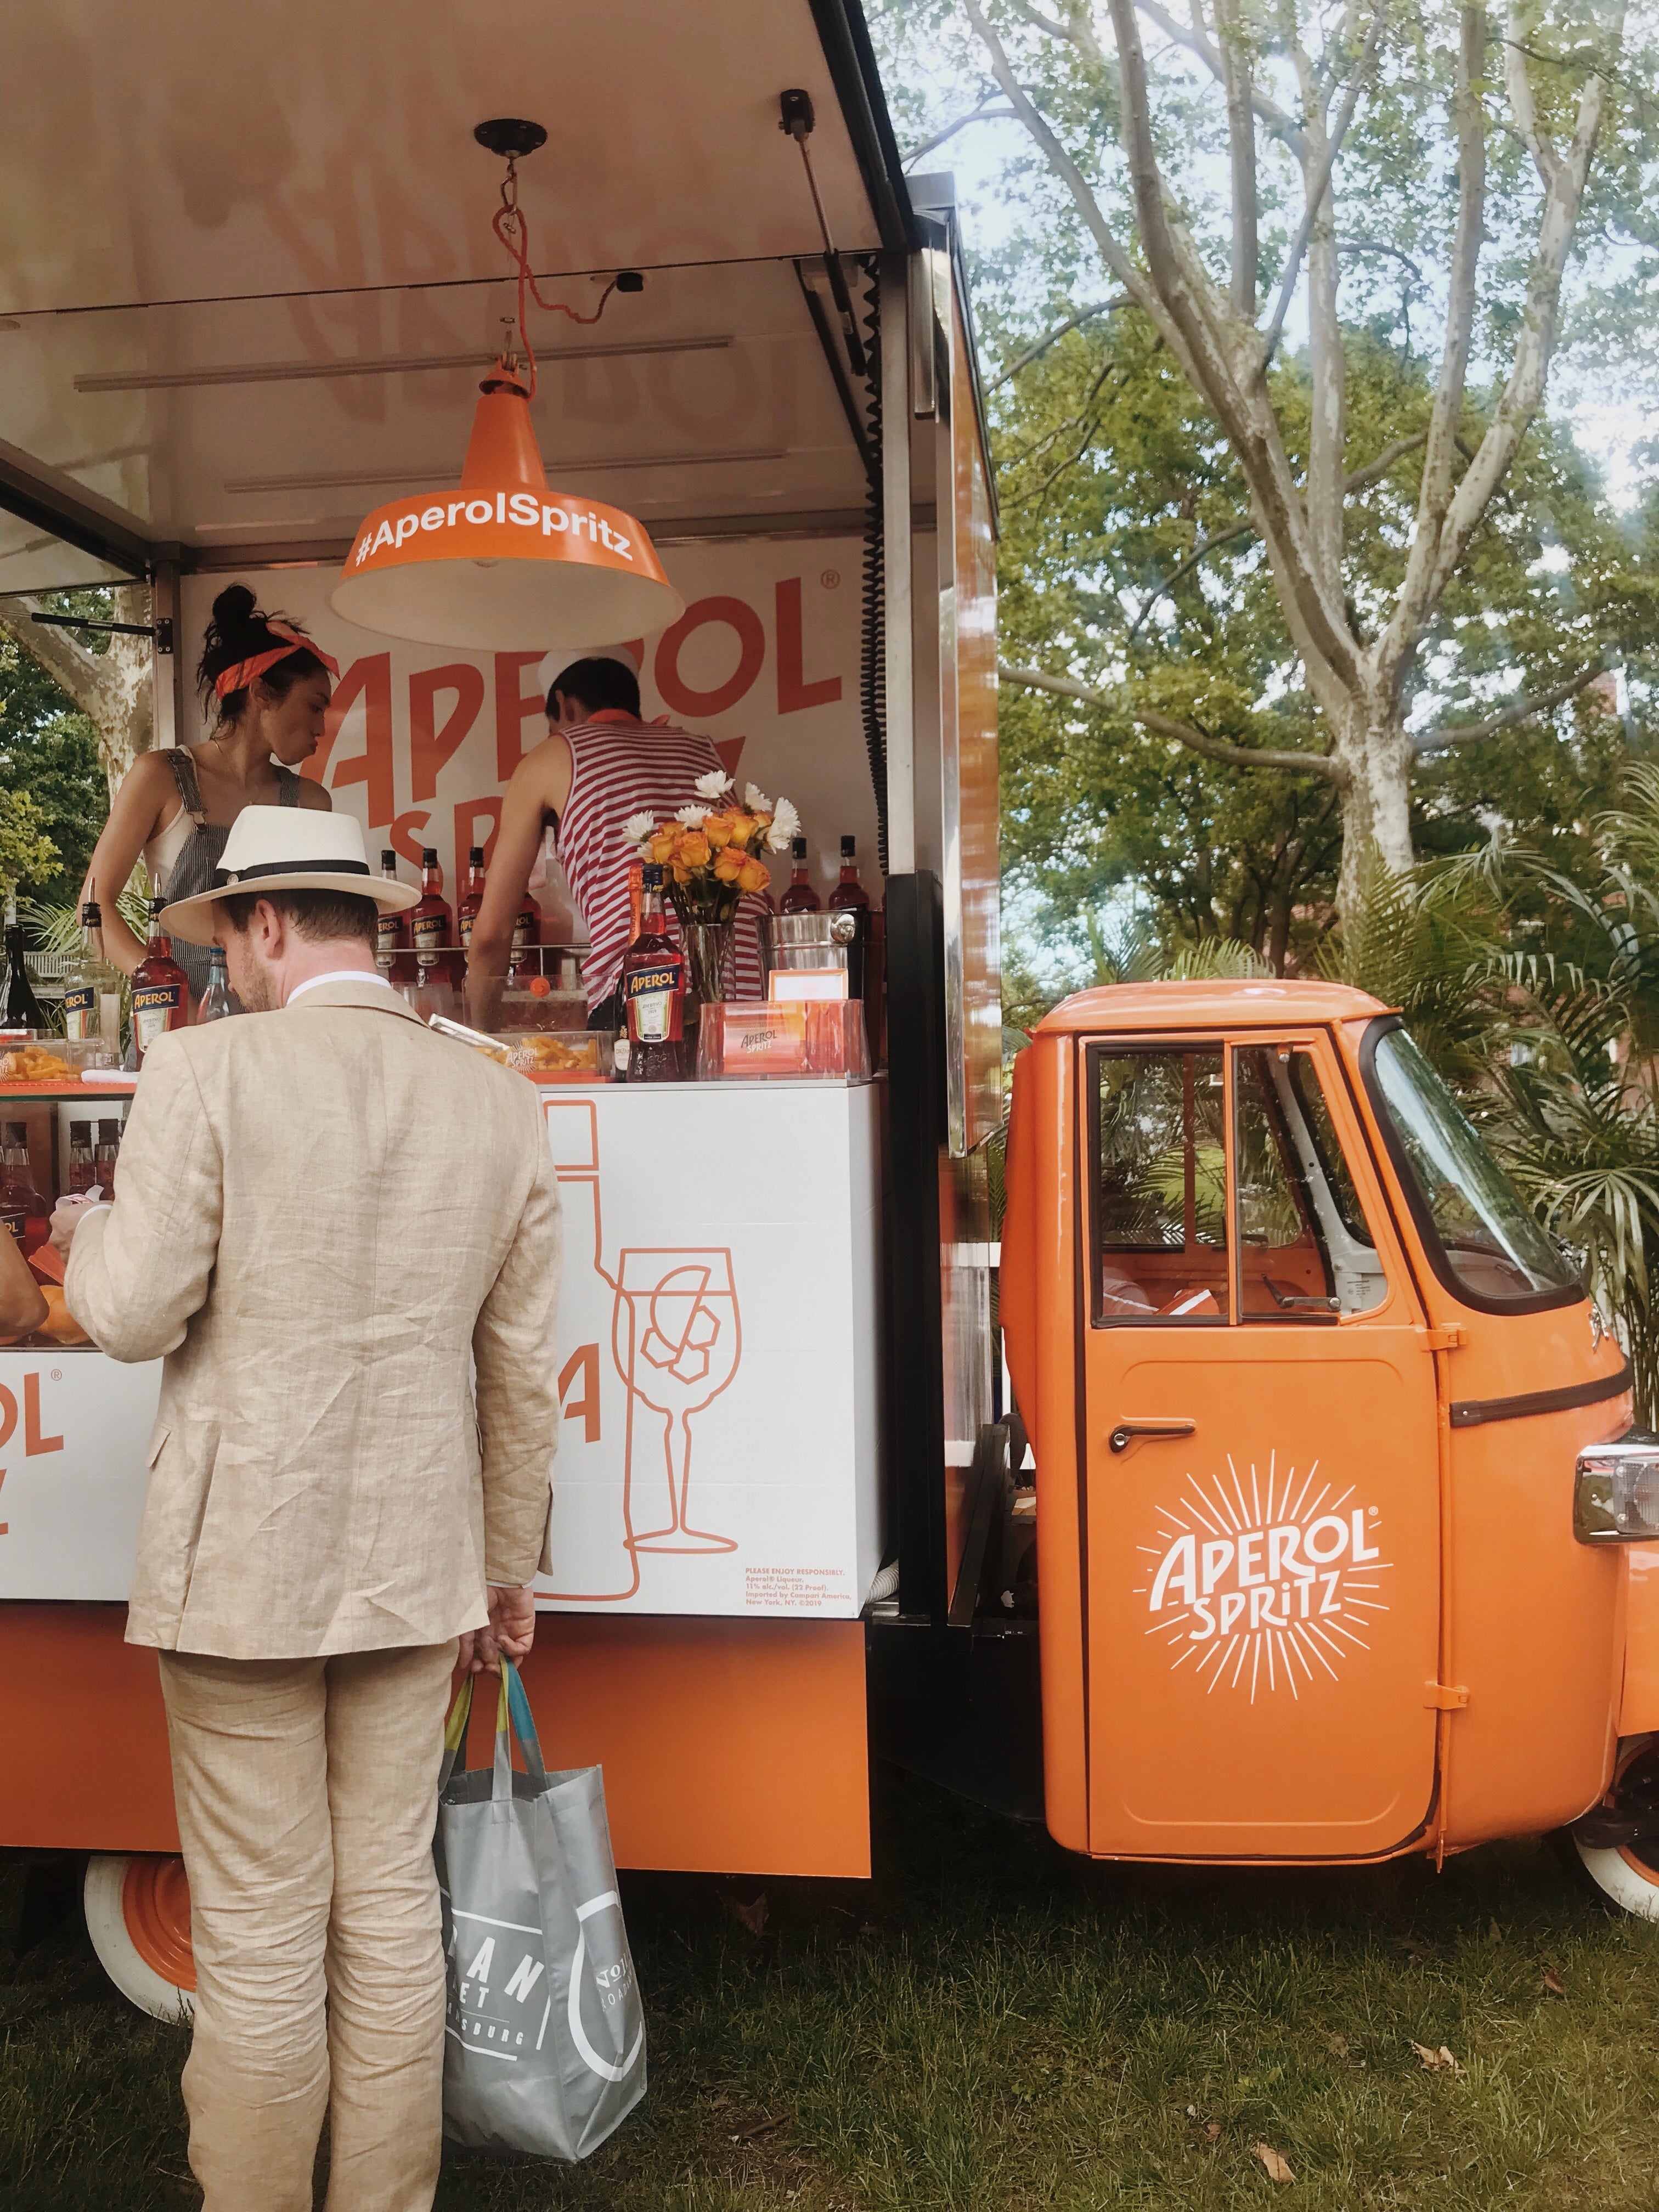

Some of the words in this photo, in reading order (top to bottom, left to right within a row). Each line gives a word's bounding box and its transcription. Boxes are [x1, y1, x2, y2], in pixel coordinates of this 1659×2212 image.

[356, 493, 633, 567] #AperolSpritz
[379, 921, 399, 932] EROL
[414, 920, 443, 934] APEROL
[461, 919, 473, 932] APE
[631, 972, 675, 994] APEROL
[134, 991, 174, 1009] APEROL
[741, 1030, 777, 1048] APEROL
[747, 1040, 772, 1053] SPRITZ
[505, 1047, 539, 1064] APEROL
